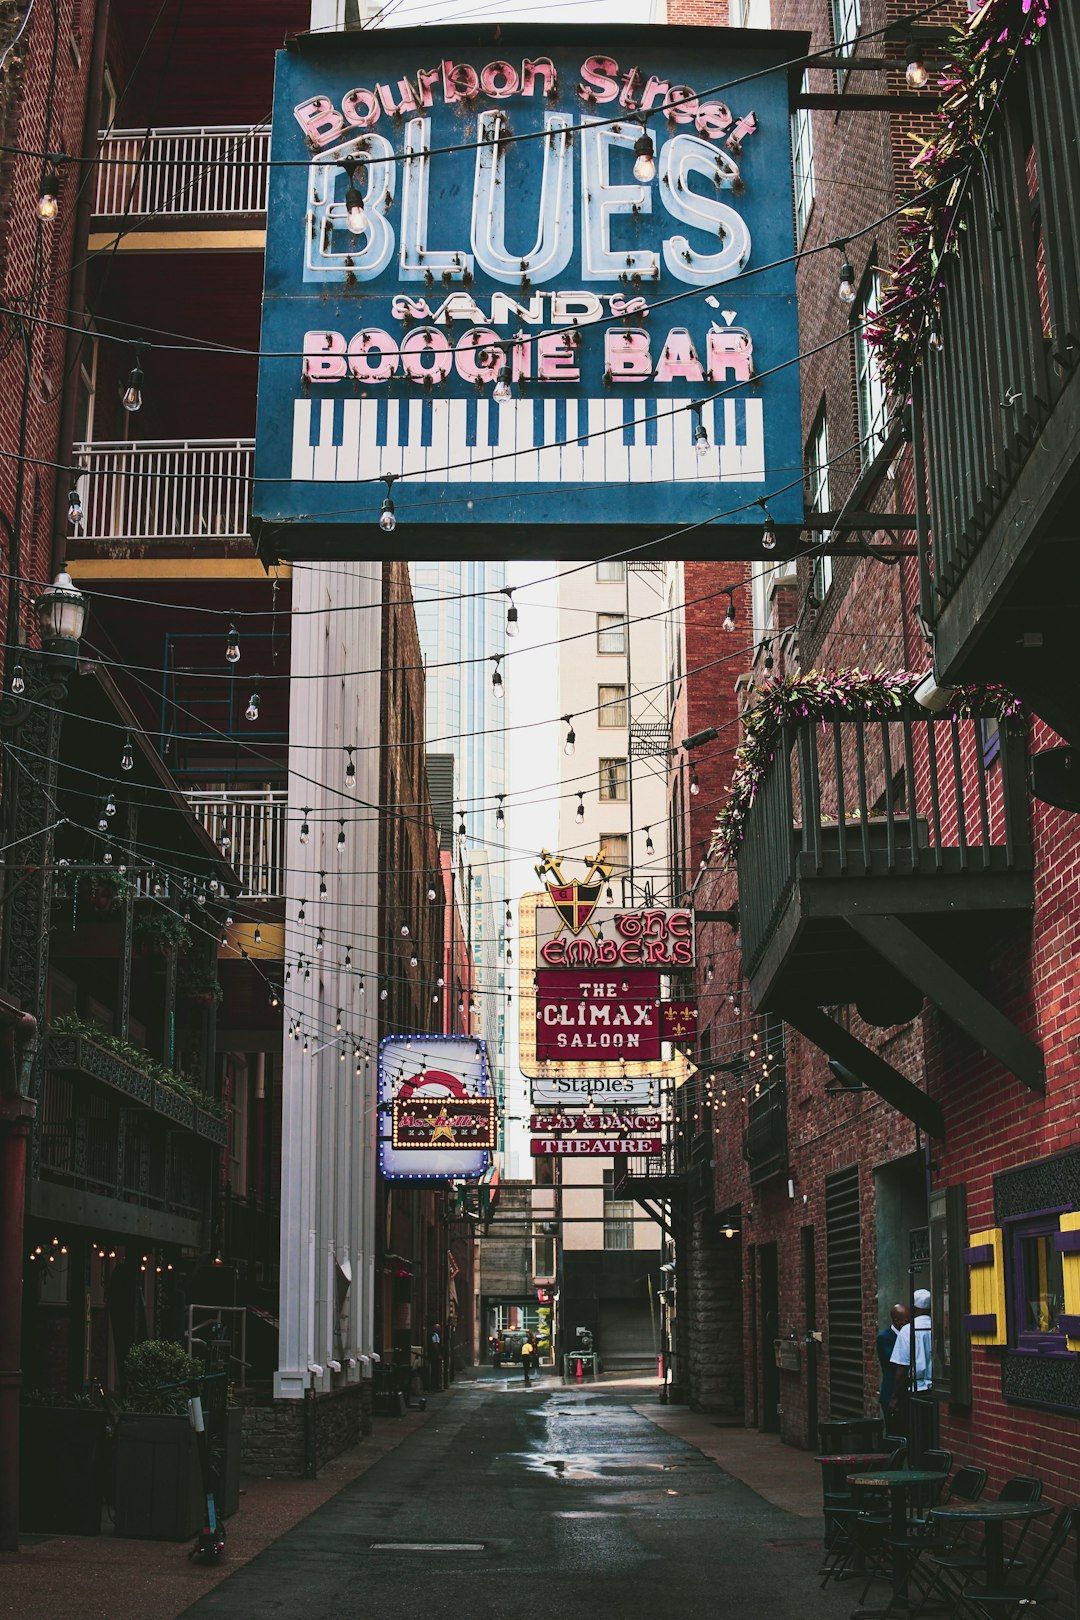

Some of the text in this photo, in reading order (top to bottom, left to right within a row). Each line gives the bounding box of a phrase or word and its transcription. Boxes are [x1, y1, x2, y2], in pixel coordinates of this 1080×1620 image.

[293, 54, 758, 148] Bourbon Street
[302, 109, 752, 285] BLUES
[431, 290, 604, 325] AND
[302, 326, 755, 384] BOOGIE BAR
[541, 938, 693, 965] EMBERS
[579, 983, 617, 998] THE
[543, 1005, 653, 1026] CLIMAX
[557, 1033, 640, 1048] SALOON
[558, 1078, 634, 1092] Stables
[398, 1115, 430, 1127] Ms.
[583, 1115, 596, 1129] &
[599, 1115, 658, 1129] DANCE
[541, 1140, 652, 1153] THEATRE
